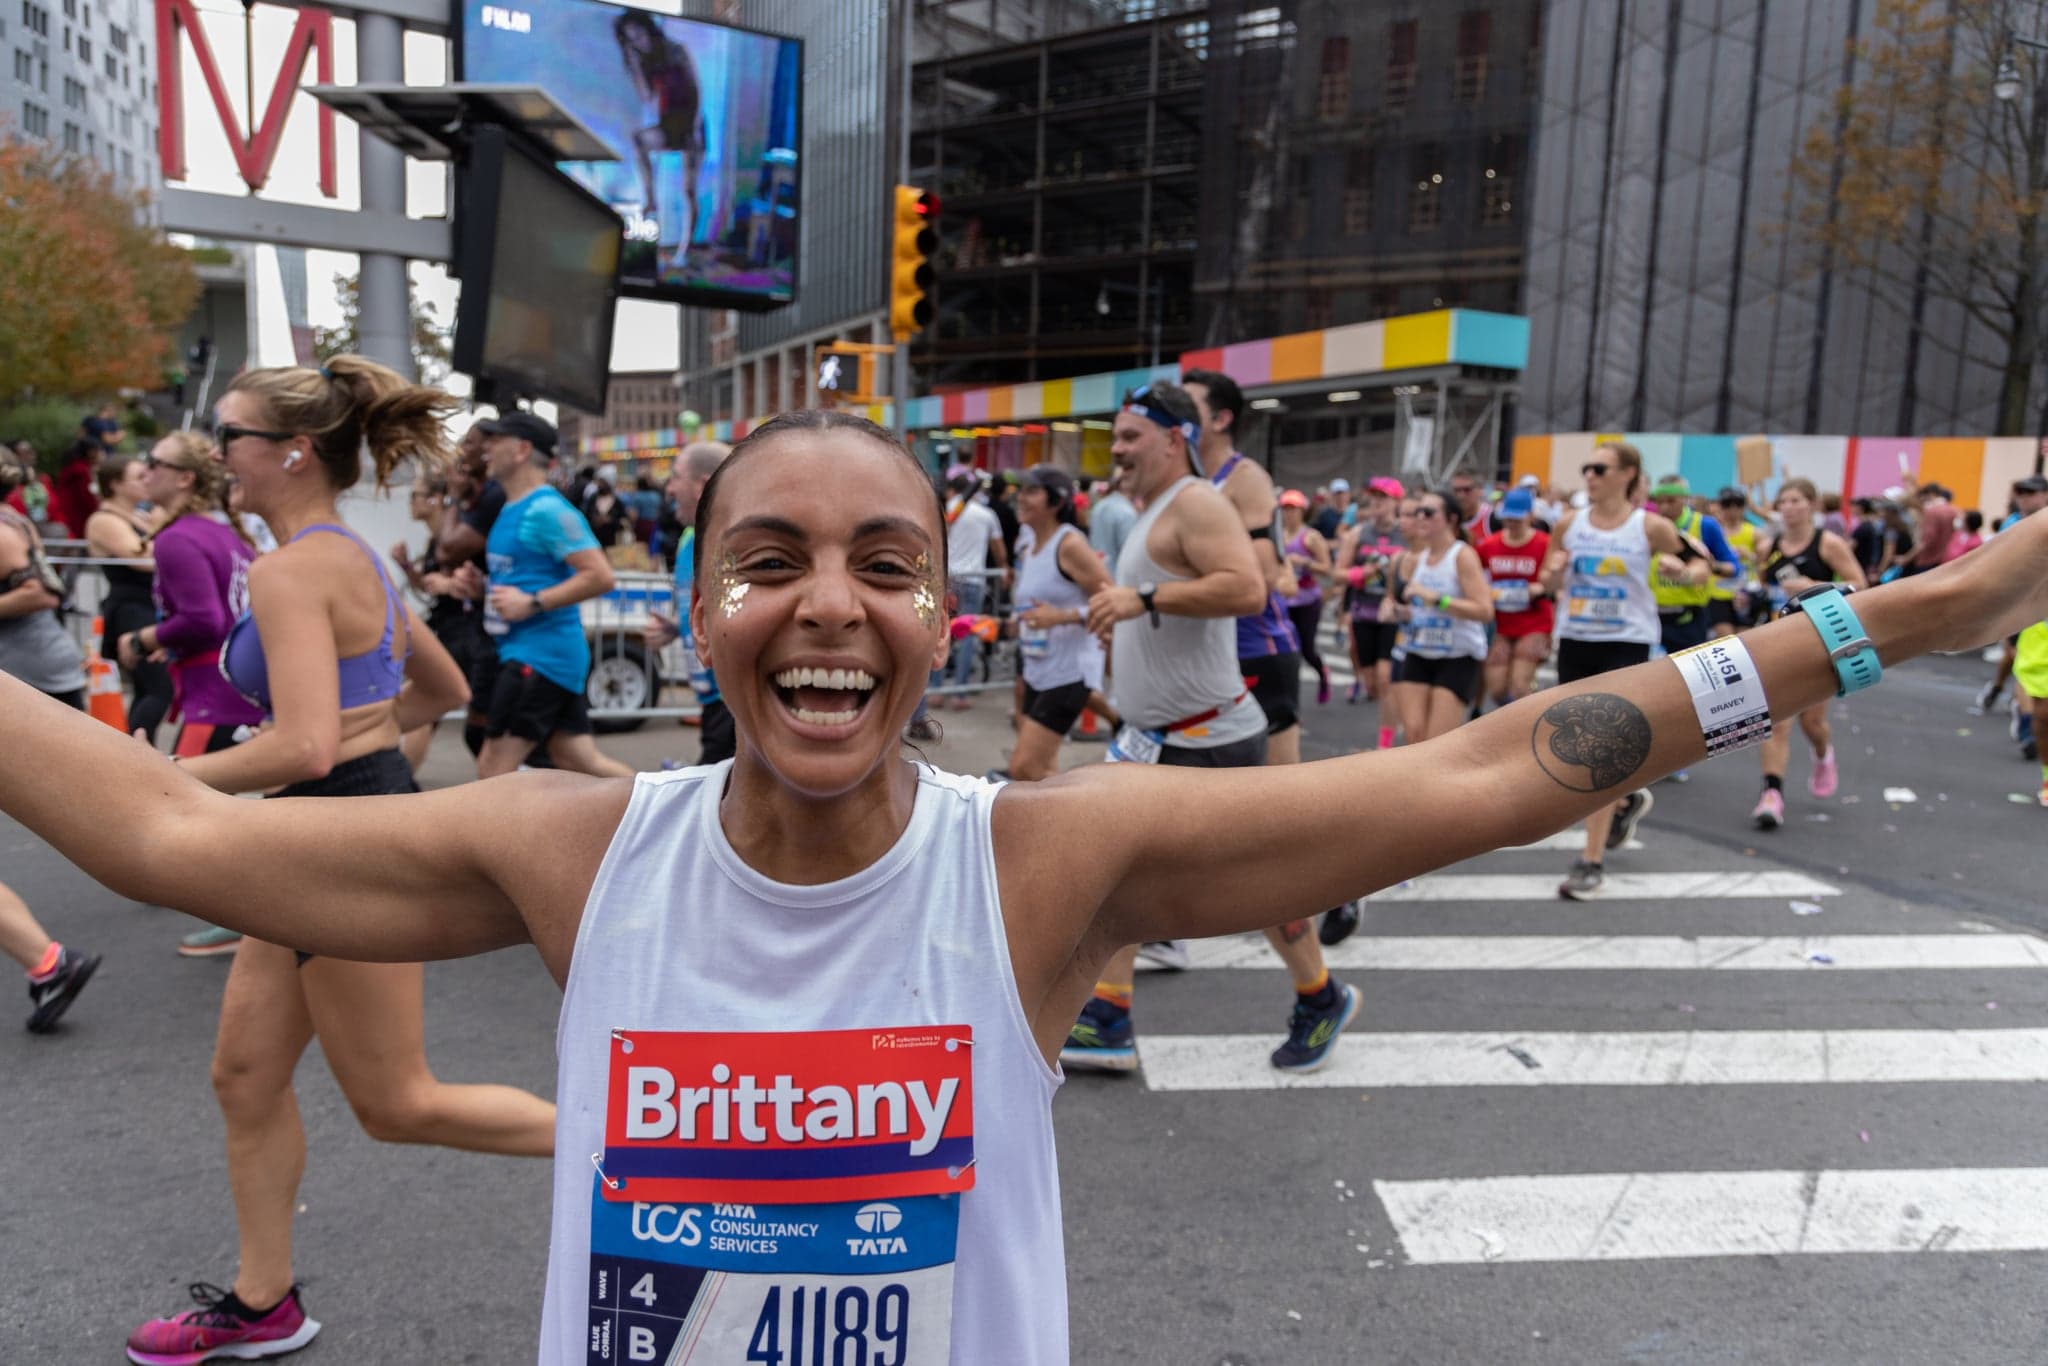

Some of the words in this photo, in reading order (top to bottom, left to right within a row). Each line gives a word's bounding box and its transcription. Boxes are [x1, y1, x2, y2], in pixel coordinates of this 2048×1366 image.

[1711, 646, 1737, 675] 4:15
[1710, 696, 1744, 714] BRAVEY
[626, 1063, 959, 1156] Brittany
[712, 1203, 756, 1219] TATA
[710, 1219, 819, 1237] CONSULTANCY
[709, 1236, 778, 1254] SERVICES
[846, 1237, 908, 1256] TATA
[598, 1270, 607, 1300] WAVE
[630, 1272, 657, 1306] 4
[592, 1325, 600, 1352] BLUE
[601, 1319, 611, 1359] CORRAL
[746, 1283, 911, 1366] 41189
[629, 1326, 656, 1361] B
